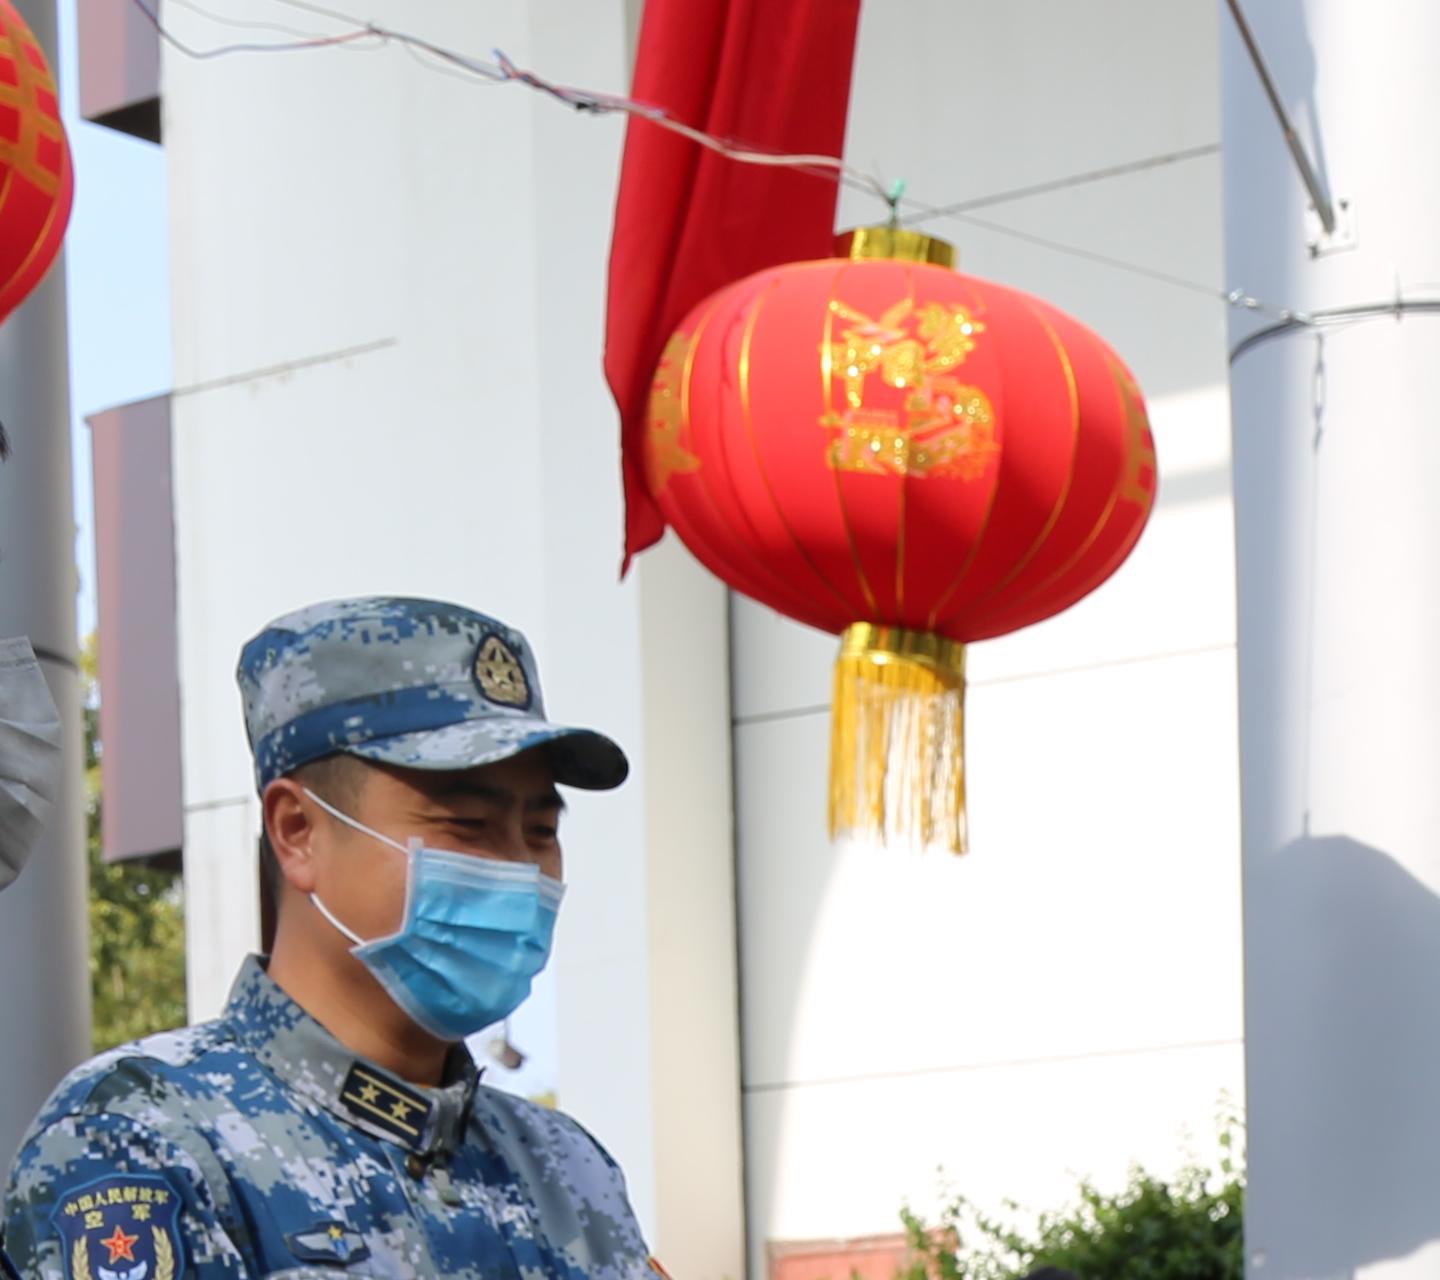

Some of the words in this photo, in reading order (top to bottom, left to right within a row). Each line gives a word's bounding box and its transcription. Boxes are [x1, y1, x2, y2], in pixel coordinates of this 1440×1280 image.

[64, 1186, 169, 1217] 中国人民解放军
